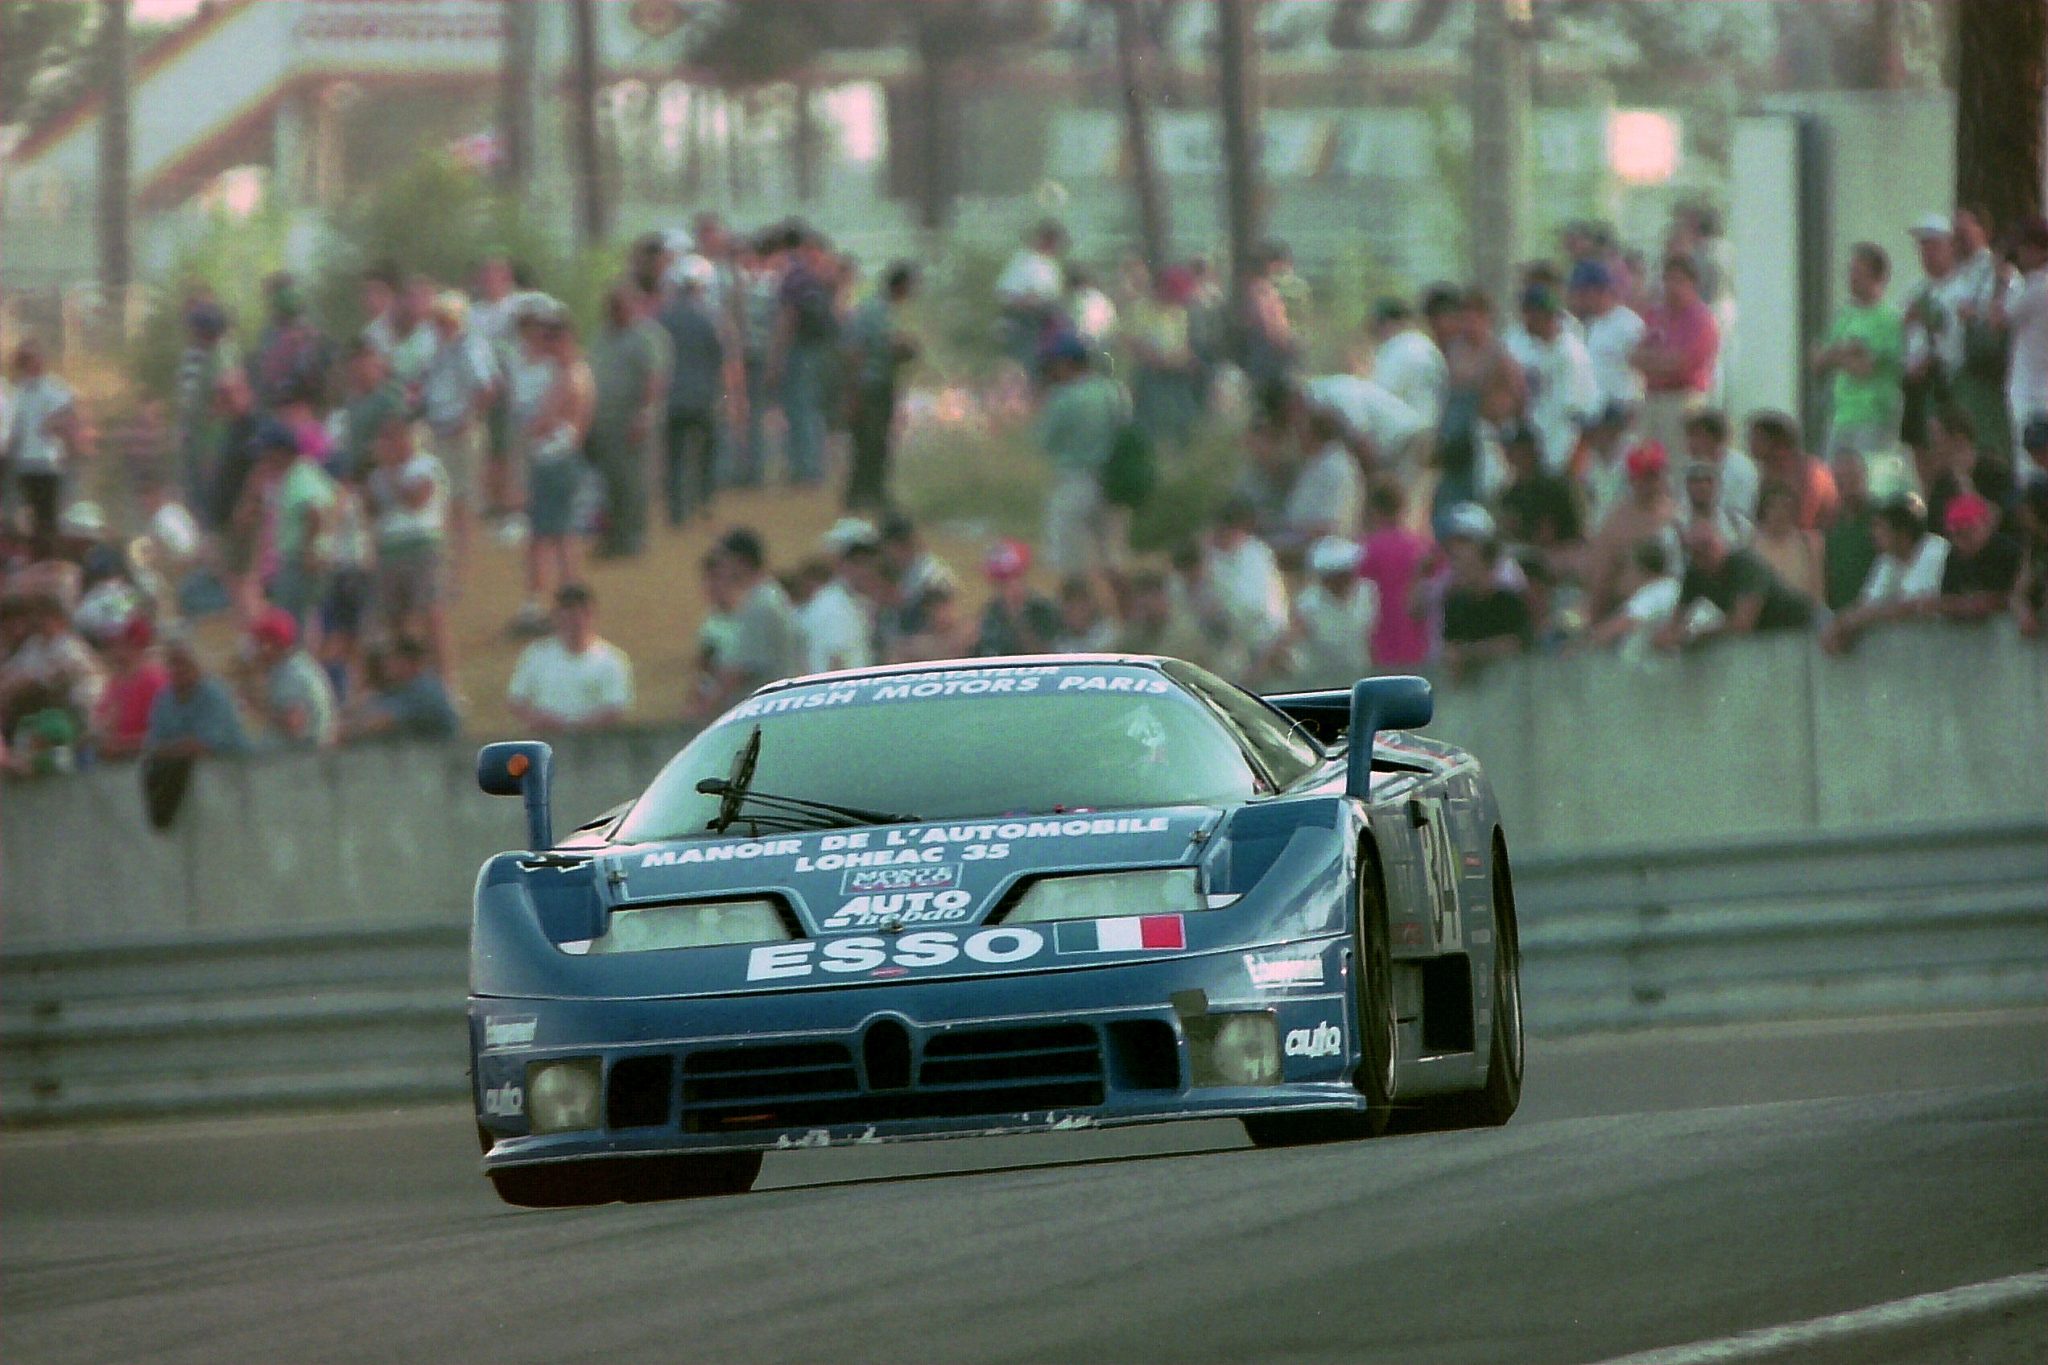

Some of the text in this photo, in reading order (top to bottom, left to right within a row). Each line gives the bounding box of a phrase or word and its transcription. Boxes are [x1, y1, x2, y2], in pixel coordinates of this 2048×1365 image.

[872, 677, 1041, 700] MOTORS
[1058, 675, 1169, 694] PARIS
[641, 817, 1169, 868] MANOIR DE L'AUTOMOBILE
[795, 843, 1011, 873] LOHEAC 35
[824, 889, 972, 927] AUTO
[857, 907, 966, 927] hebdo
[747, 927, 1044, 982] ESSO
[1285, 1020, 1341, 1058] auto
